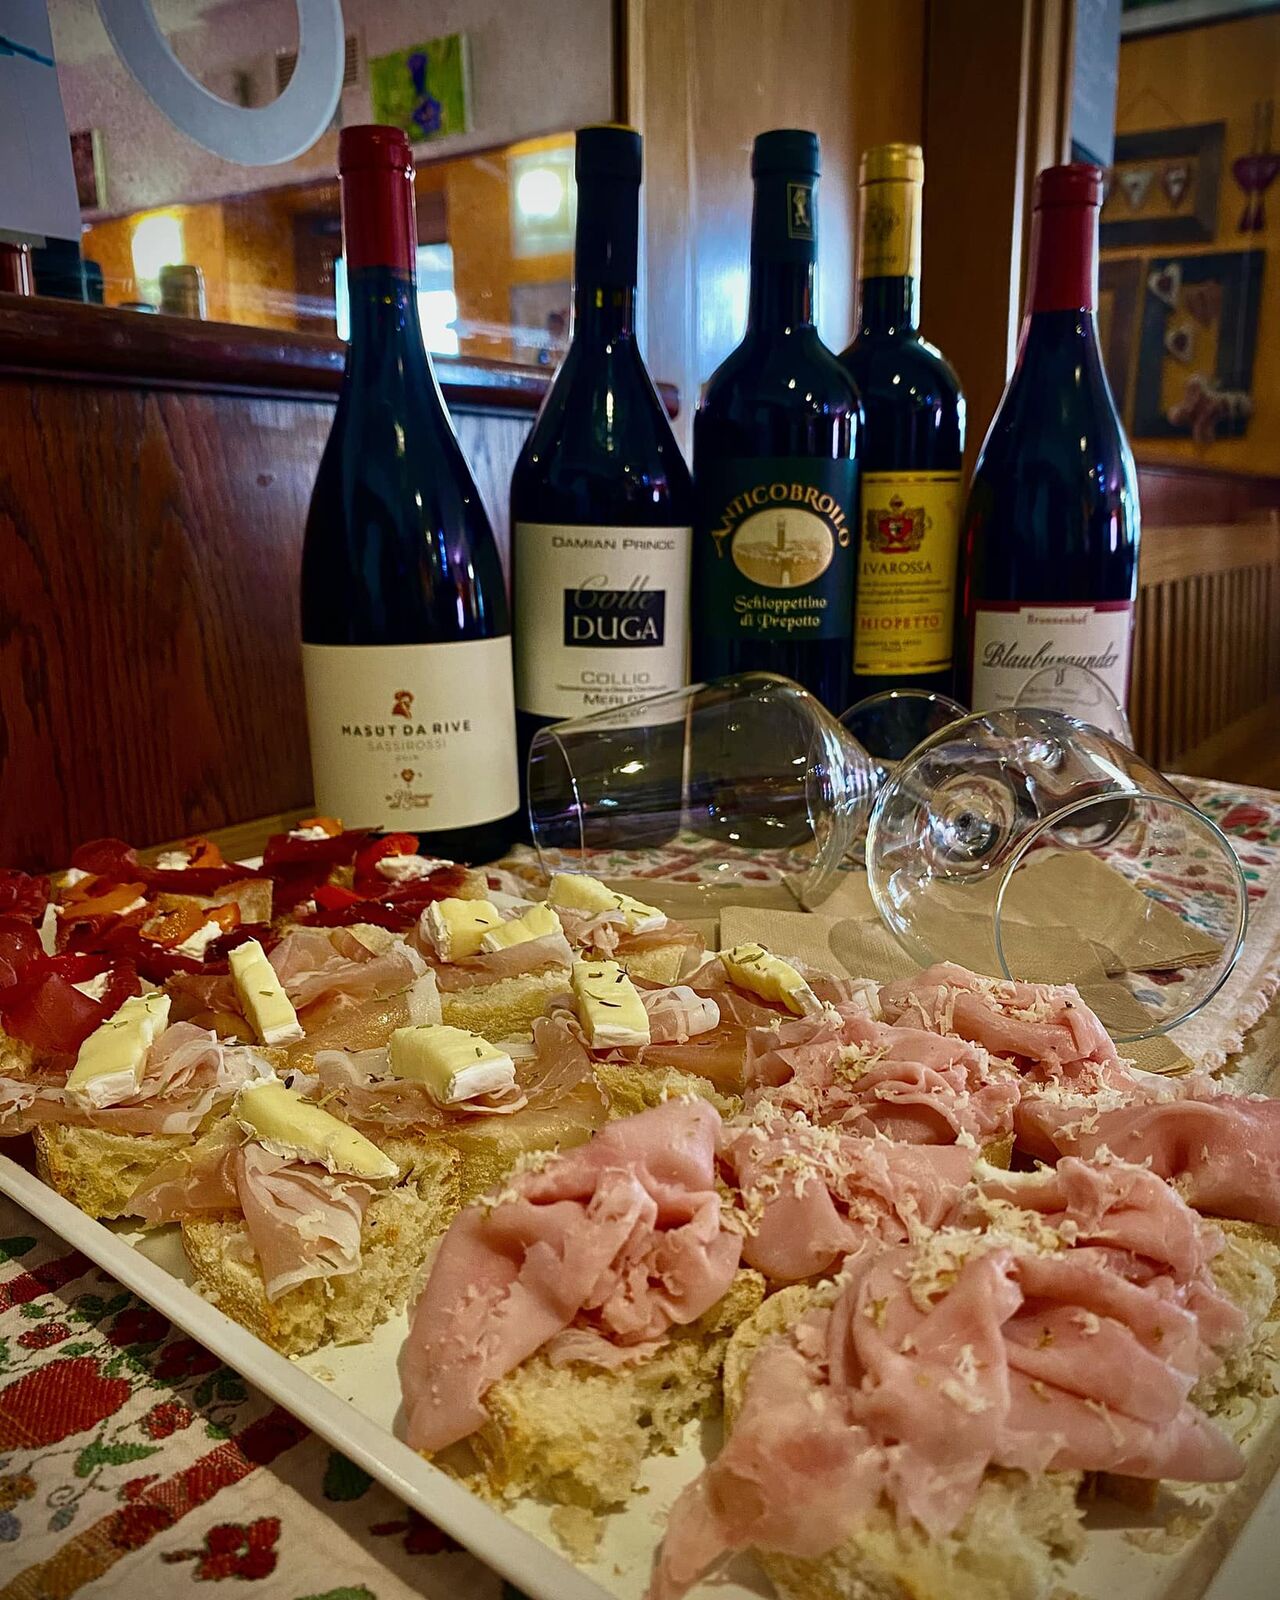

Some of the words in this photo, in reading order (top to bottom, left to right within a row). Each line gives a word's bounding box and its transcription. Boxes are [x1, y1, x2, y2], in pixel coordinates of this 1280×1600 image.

[552, 536, 616, 550] DAMIAN
[863, 561, 932, 576] IVAROSSA
[574, 573, 657, 610] Colle
[572, 615, 659, 641] DUGA
[860, 614, 940, 630] HIOPETTO
[581, 671, 651, 685] COLLIO
[341, 724, 397, 737] MASUT
[403, 724, 427, 737] DA
[432, 719, 472, 734] RIVE
